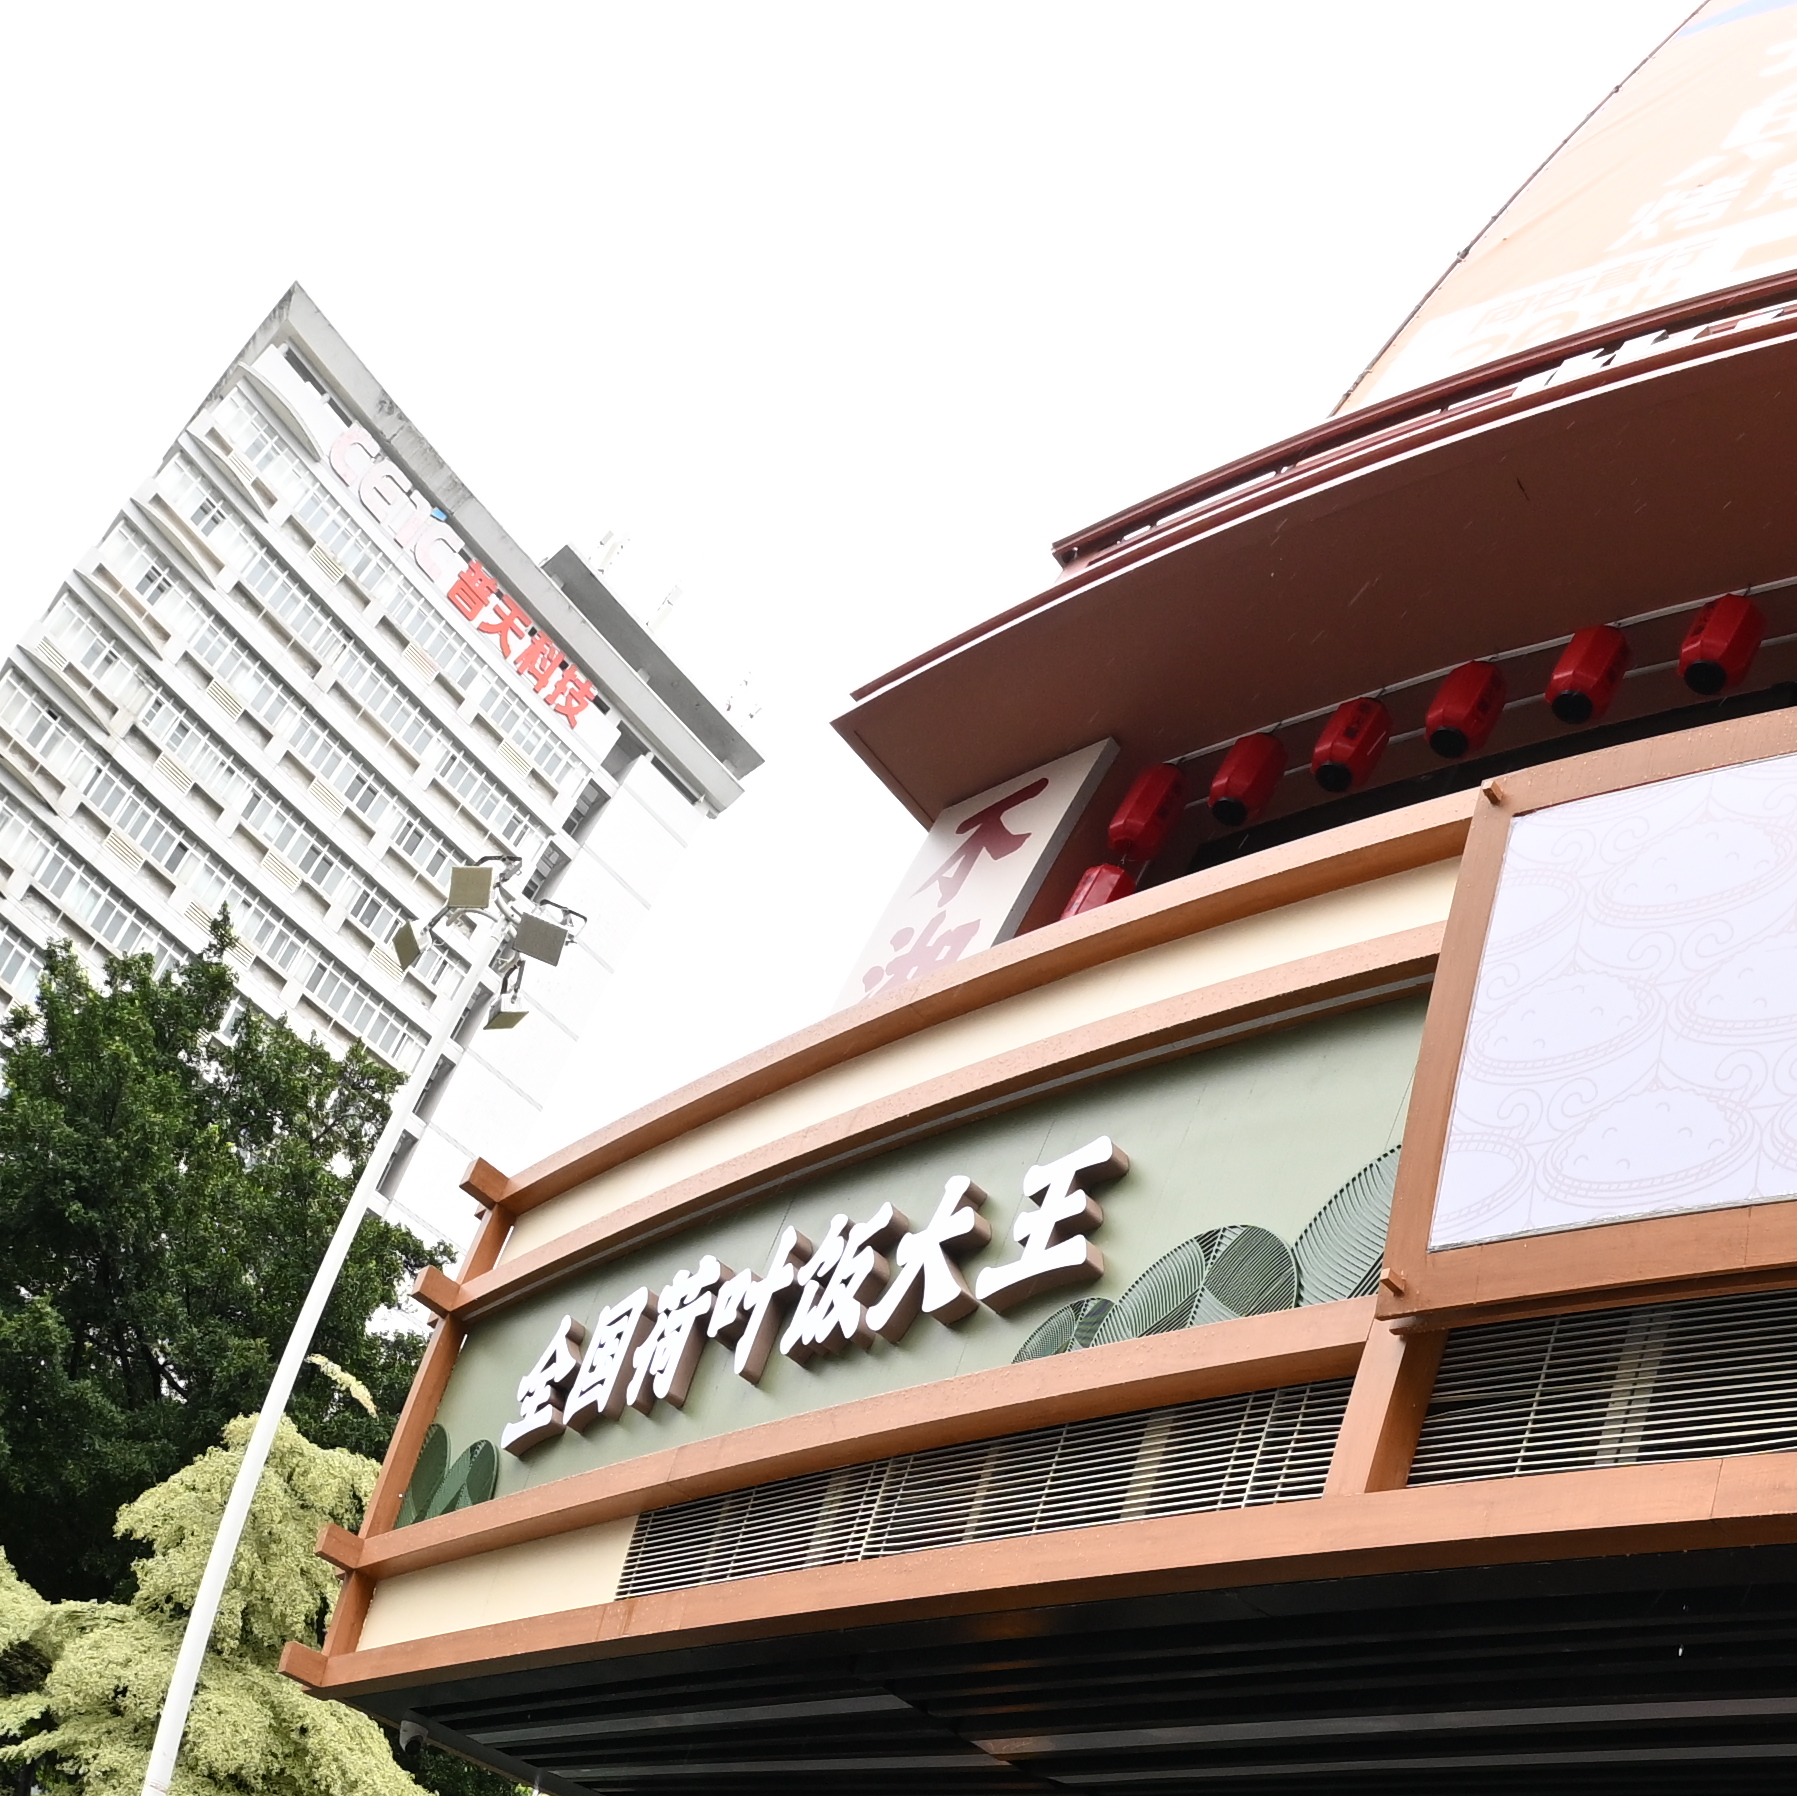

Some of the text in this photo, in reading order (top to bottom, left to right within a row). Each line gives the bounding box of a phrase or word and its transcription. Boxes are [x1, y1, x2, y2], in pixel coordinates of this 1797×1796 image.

[447, 557, 599, 729] 普天科技
[500, 1135, 1126, 1456] 全国荷叶饭大王
